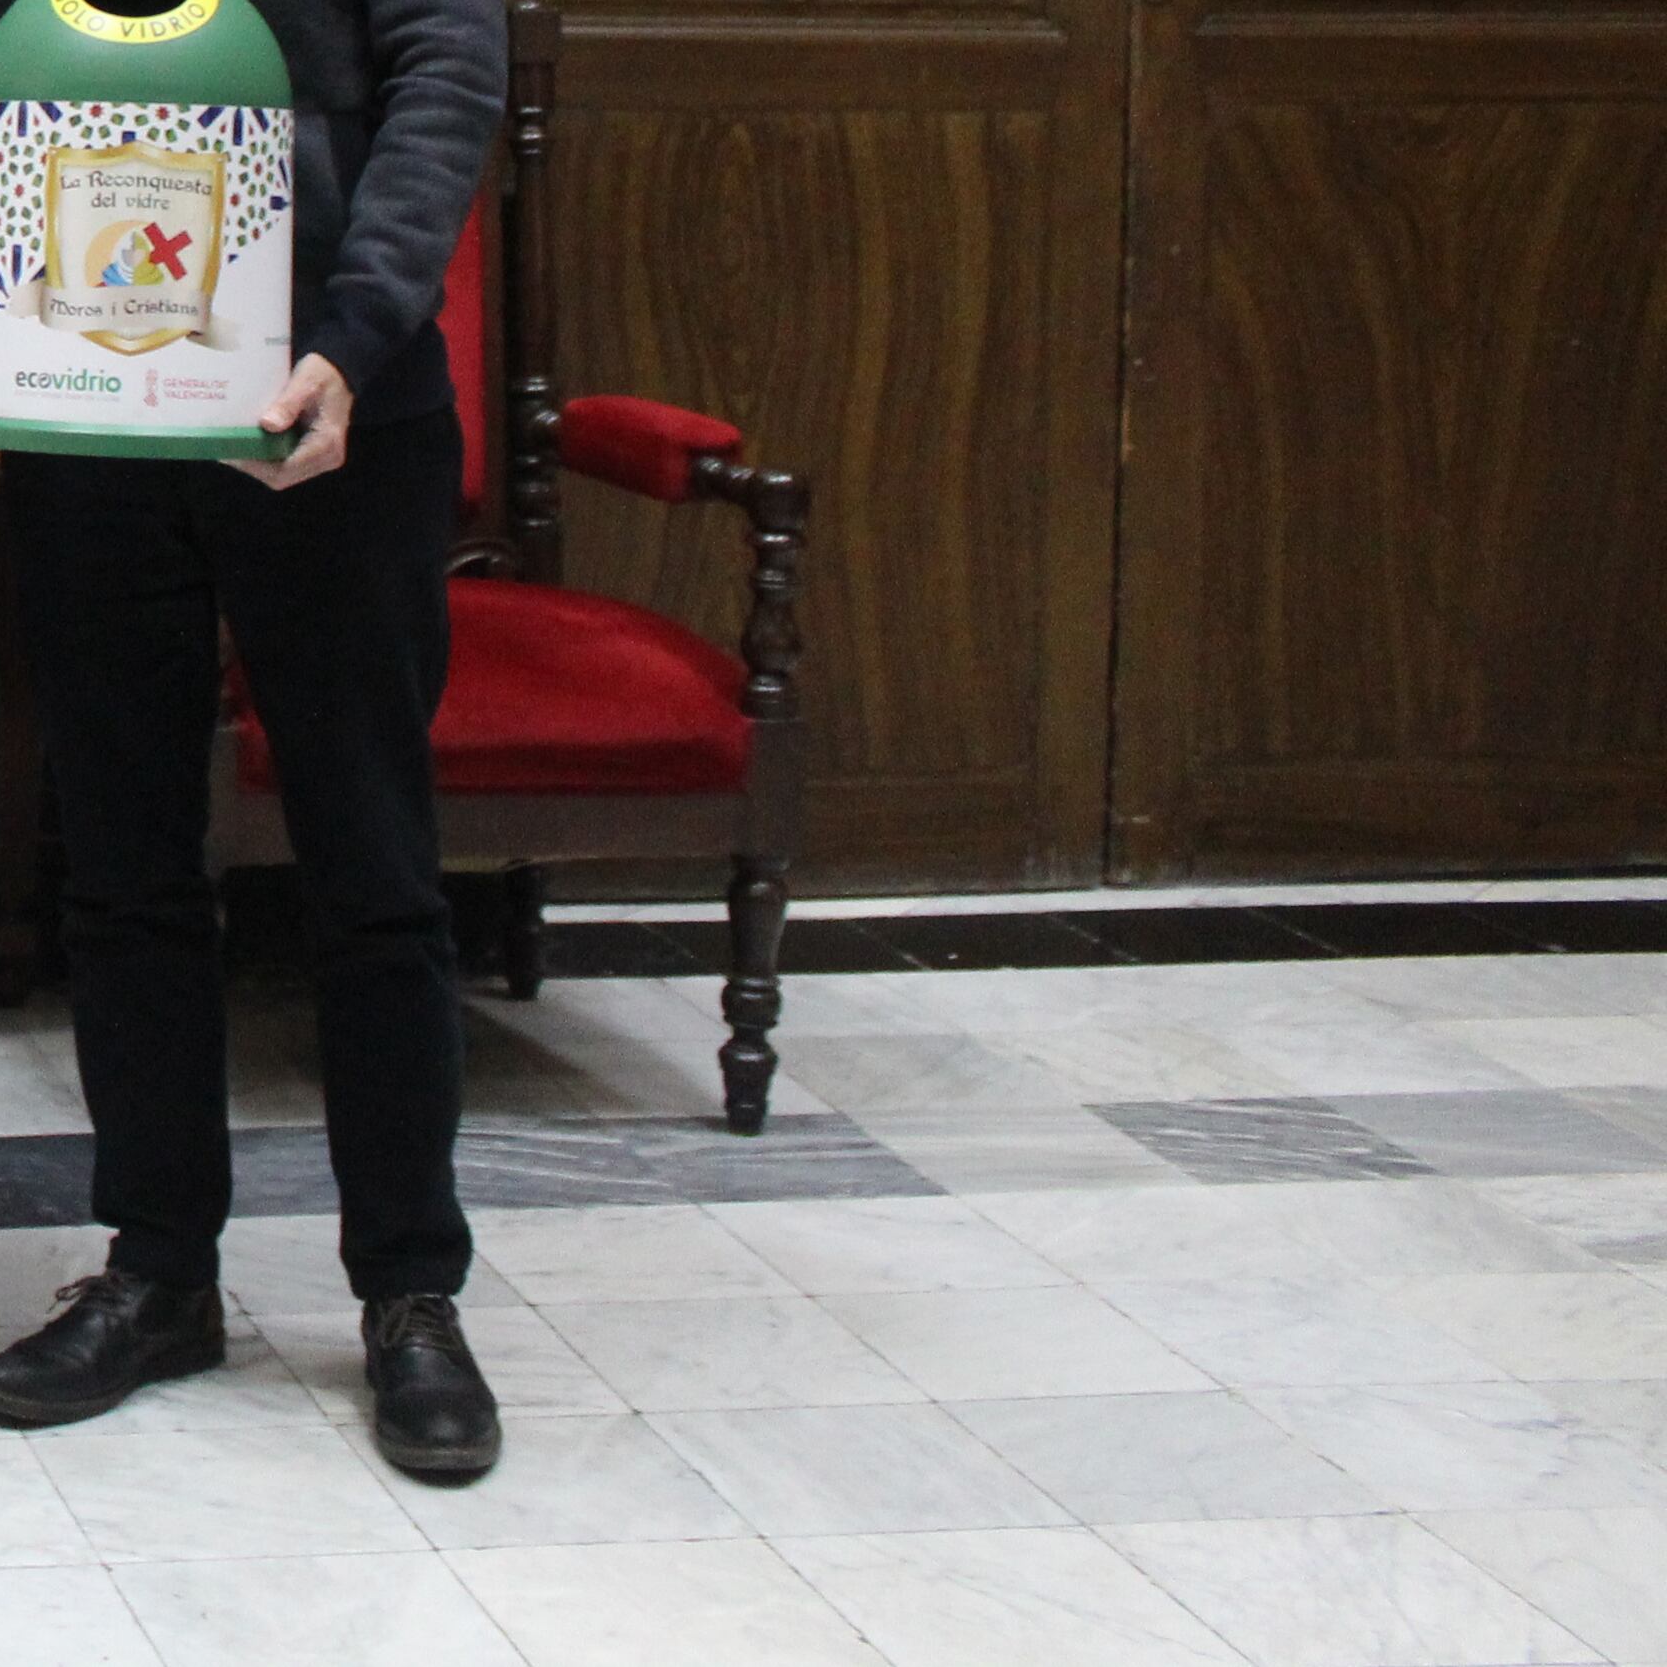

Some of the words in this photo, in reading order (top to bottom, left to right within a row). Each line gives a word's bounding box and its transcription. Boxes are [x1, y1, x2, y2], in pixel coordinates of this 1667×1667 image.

[121, 3, 205, 39] VIDRIO
[88, 170, 212, 196] Reconquesta
[91, 192, 116, 208] del
[125, 193, 171, 210] vidre
[124, 298, 198, 316] Cristians
[15, 368, 121, 393] ecovidrio
